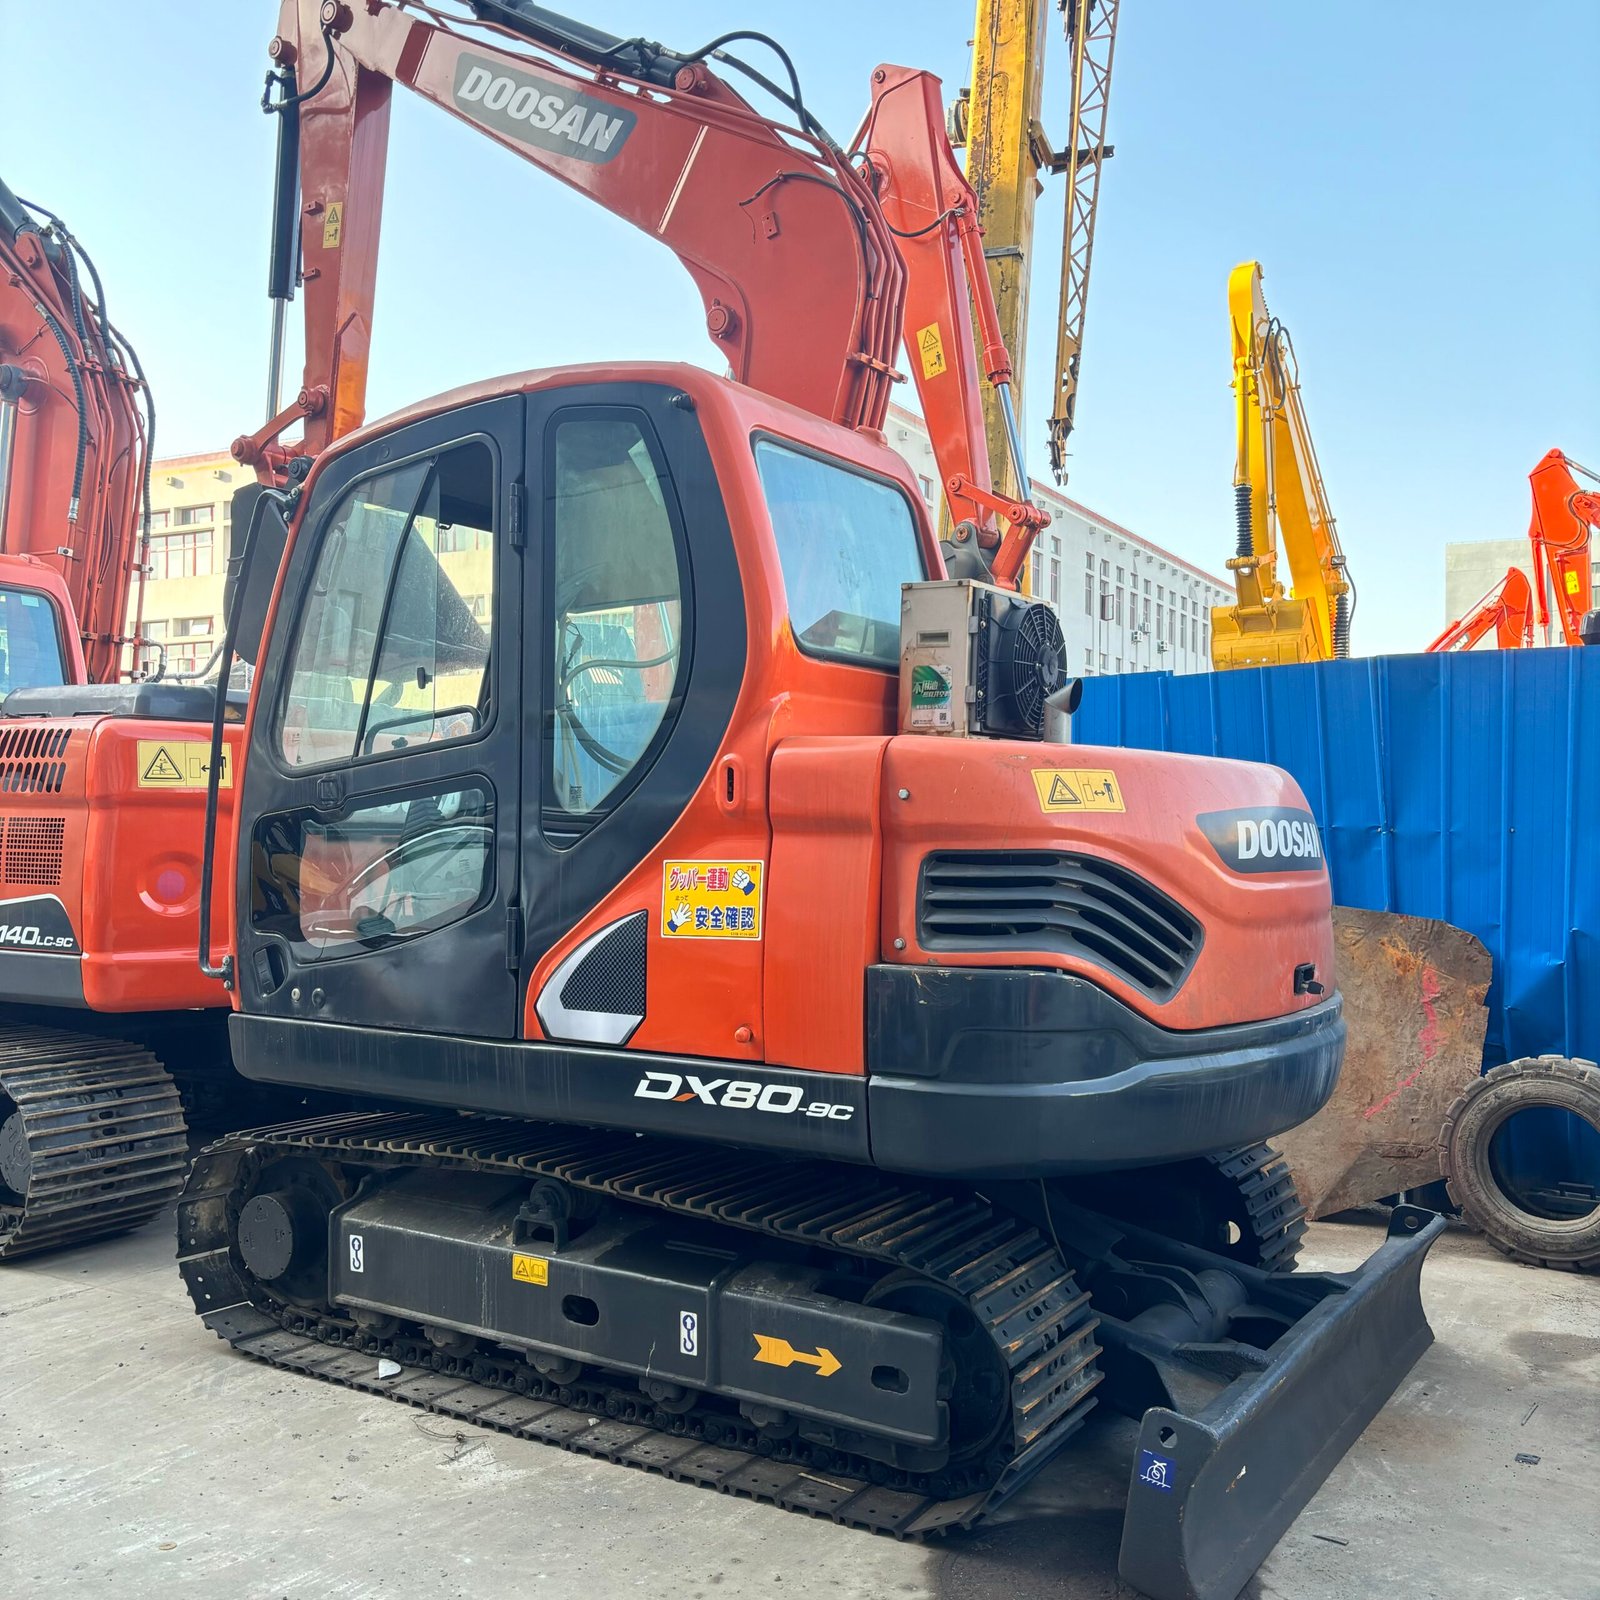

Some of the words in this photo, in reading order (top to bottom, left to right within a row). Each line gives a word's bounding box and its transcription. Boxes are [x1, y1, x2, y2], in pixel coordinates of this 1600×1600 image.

[457, 66, 624, 152] DOOSAN
[1236, 818, 1321, 860] DOOSAN
[669, 866, 730, 891] グッパー運動
[695, 905, 755, 931] 安全確認
[633, 1071, 855, 1121] DX80-9C
